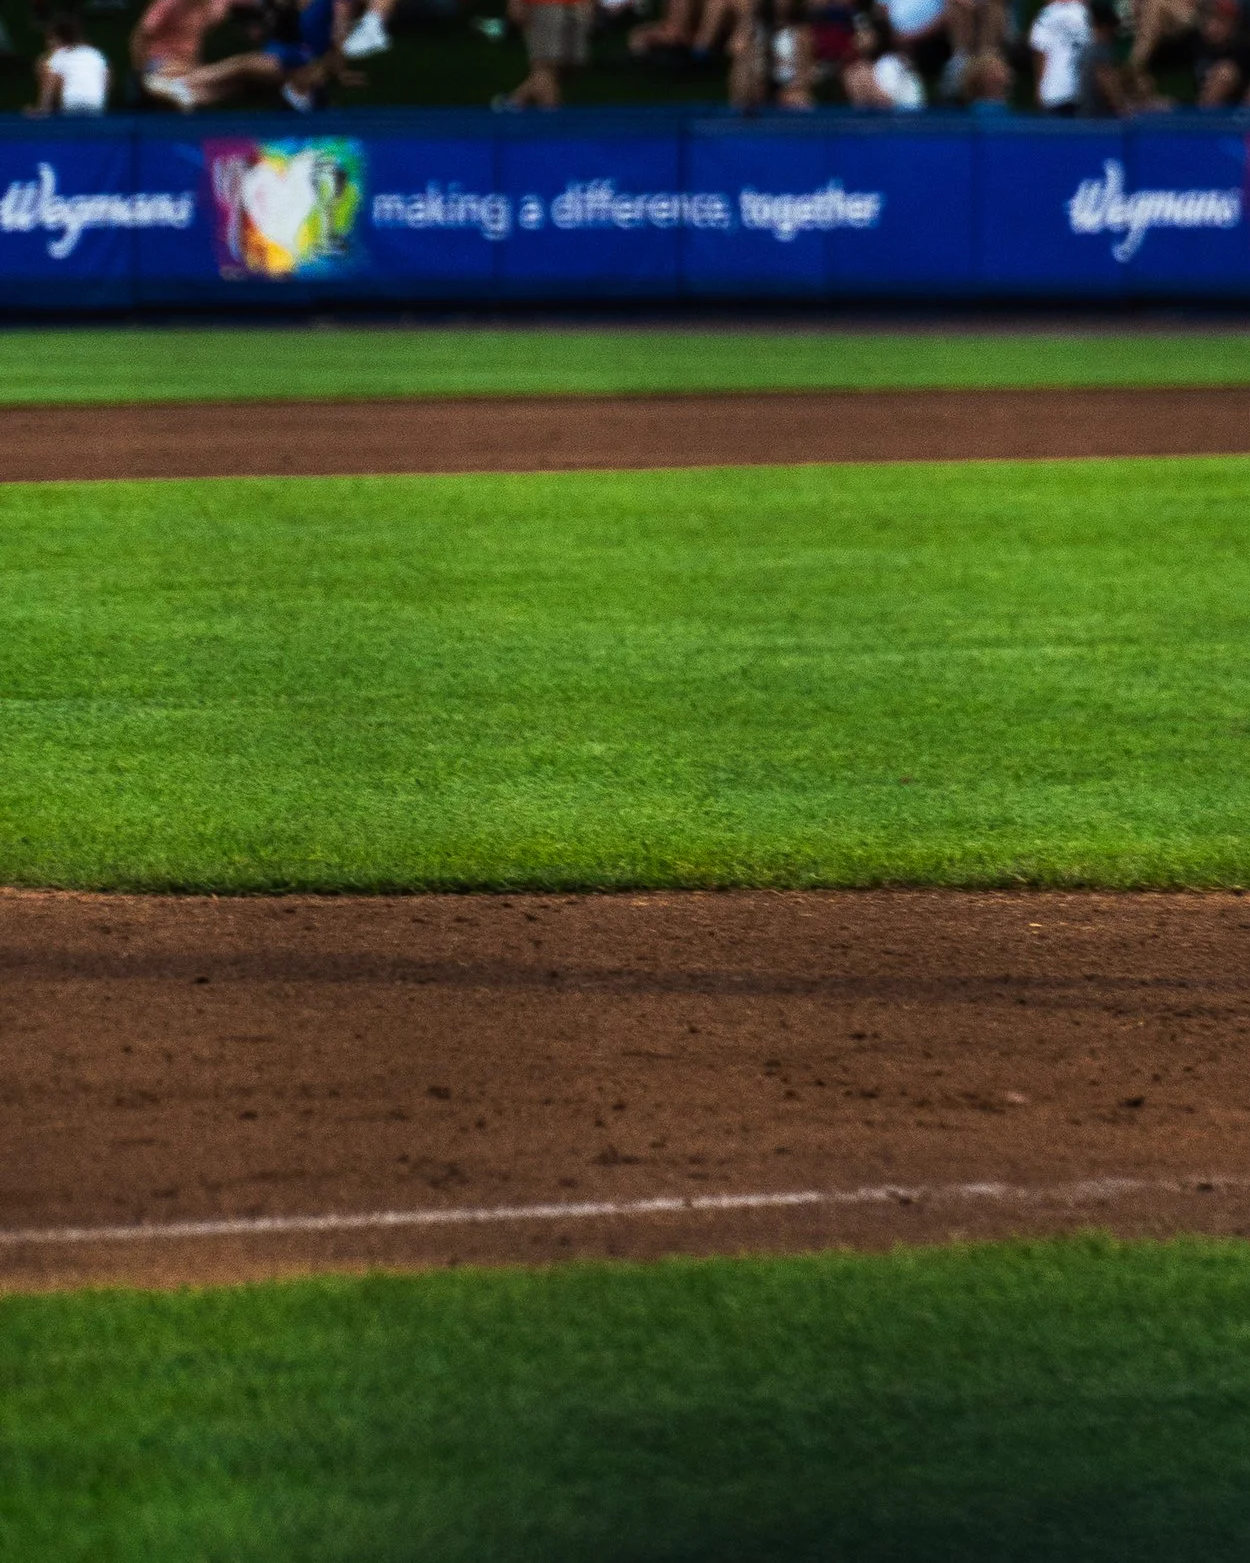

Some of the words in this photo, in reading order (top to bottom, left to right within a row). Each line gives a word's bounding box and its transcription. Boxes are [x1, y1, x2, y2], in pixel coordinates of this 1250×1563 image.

[372, 181, 511, 240] making
[518, 194, 545, 229] a
[739, 178, 882, 242] together
